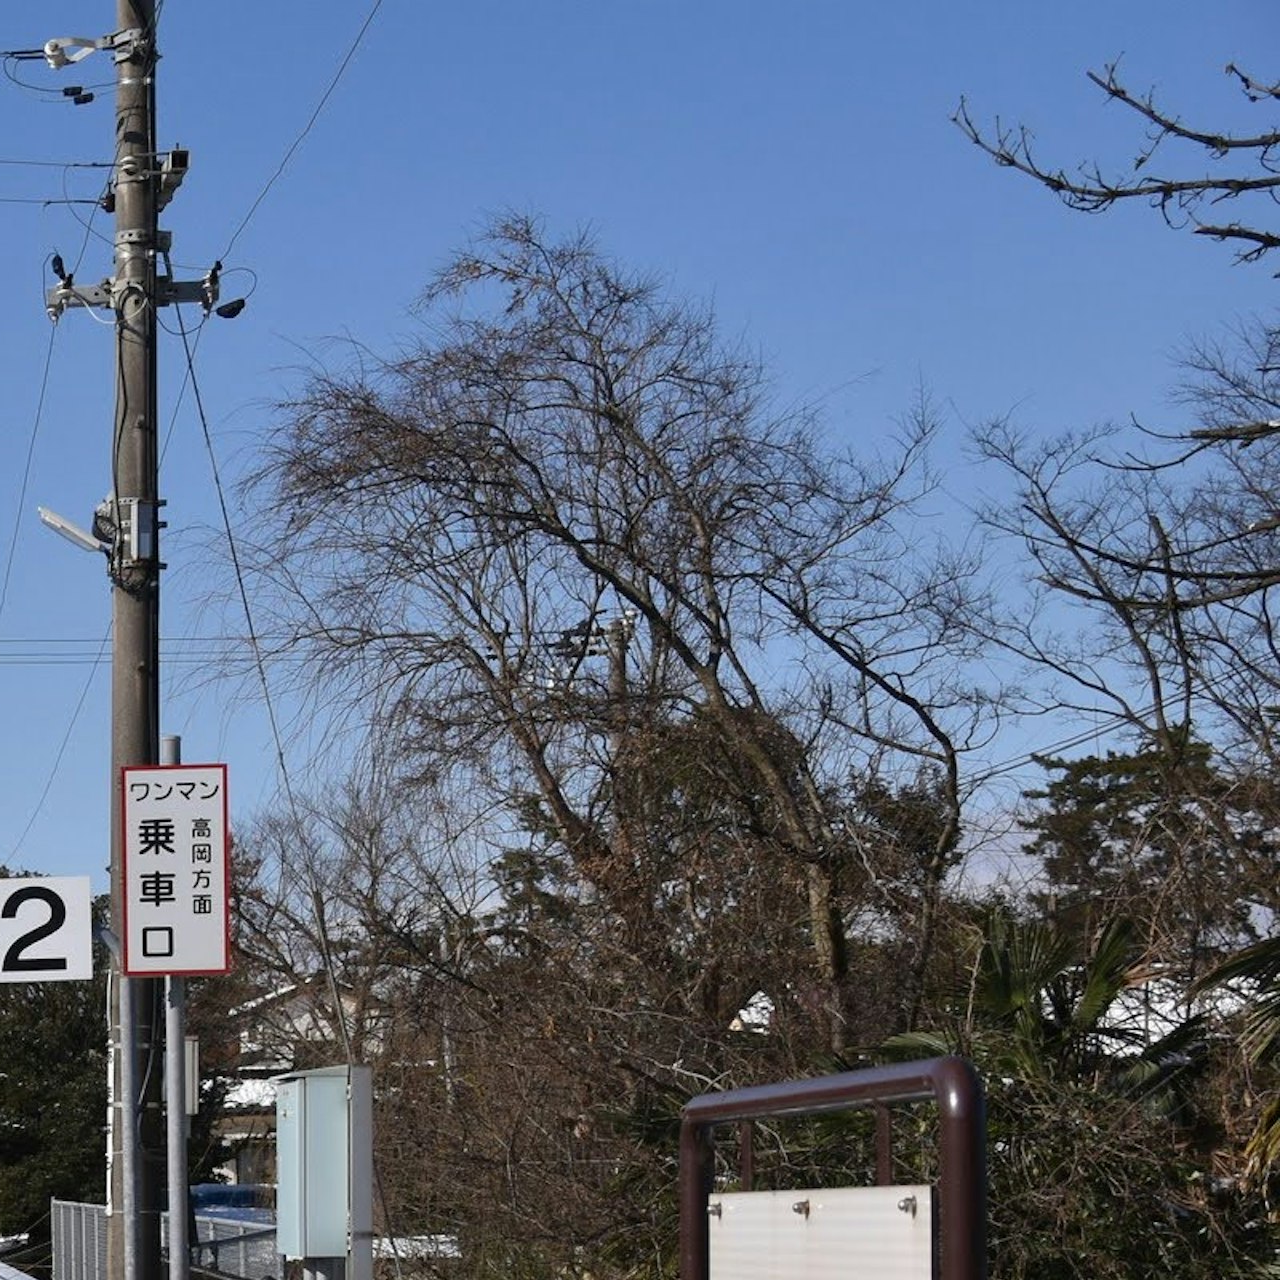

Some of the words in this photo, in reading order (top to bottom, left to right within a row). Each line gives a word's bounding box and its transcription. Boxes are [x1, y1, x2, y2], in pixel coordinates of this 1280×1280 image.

[130, 782, 219, 801] ワンマン
[138, 818, 176, 957] 乗車口
[191, 817, 212, 914] 高岡方面
[1, 886, 67, 972] 2
